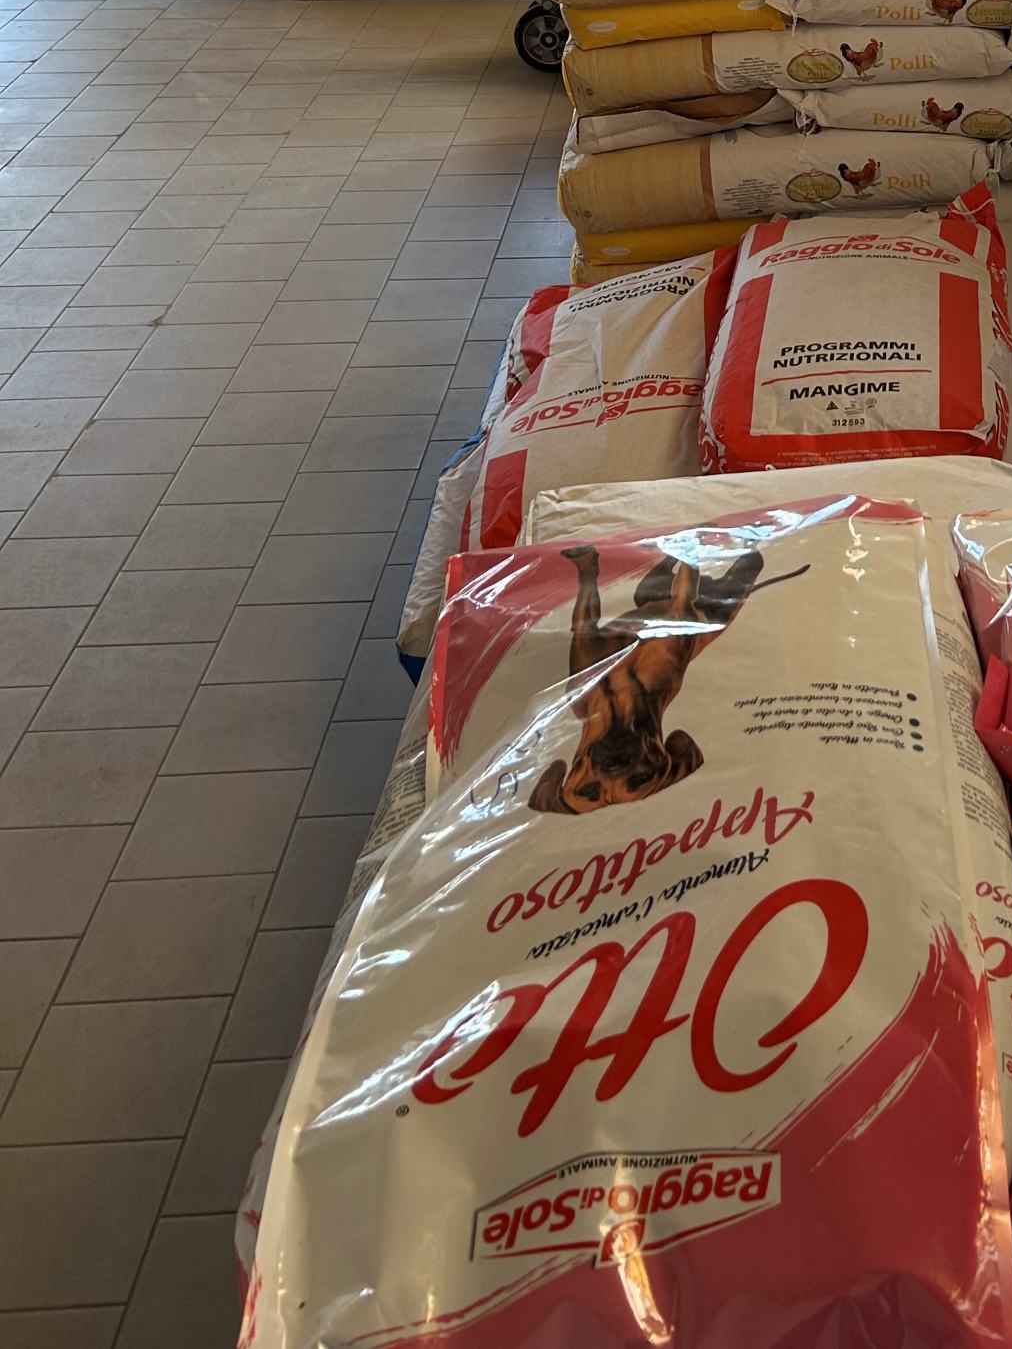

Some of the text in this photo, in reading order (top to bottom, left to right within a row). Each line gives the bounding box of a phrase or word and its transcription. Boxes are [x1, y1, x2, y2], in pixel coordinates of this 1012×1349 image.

[875, 4, 922, 21] Polli
[888, 54, 934, 72] Polli
[872, 112, 917, 129] Polli
[759, 239, 961, 268] Raggio di Sole
[808, 253, 909, 262] NUTRIZIONE ANIMALE
[590, 265, 681, 293] MANGIME
[568, 275, 694, 309] NUTRIZIONALI
[570, 284, 688, 313] PROGRAMMI
[780, 340, 916, 358] PROGRAMMI
[772, 351, 922, 370] NUTRIZIONALI
[611, 374, 670, 386] NUTRIZIONE
[789, 380, 901, 401] MANGIME
[509, 381, 703, 434] aggio di Sole
[809, 682, 838, 691] Italia
[855, 684, 900, 697] Prodotto
[733, 696, 758, 709] pelo
[759, 697, 777, 706] del
[752, 710, 773, 719] che
[816, 708, 836, 716] olio
[866, 710, 903, 723] Omega
[742, 720, 904, 736] Con Riso facilmente digeribile
[818, 735, 859, 745] Maiale
[876, 737, 905, 749] Ricco
[488, 785, 816, 934] Appetitoso
[526, 849, 771, 962] Alimenta l'amicizia
[411, 877, 870, 1139] Otto
[557, 1153, 698, 1179] NUTRIZIONE ANIMALE
[482, 1160, 773, 1249] Raggio di Sole
